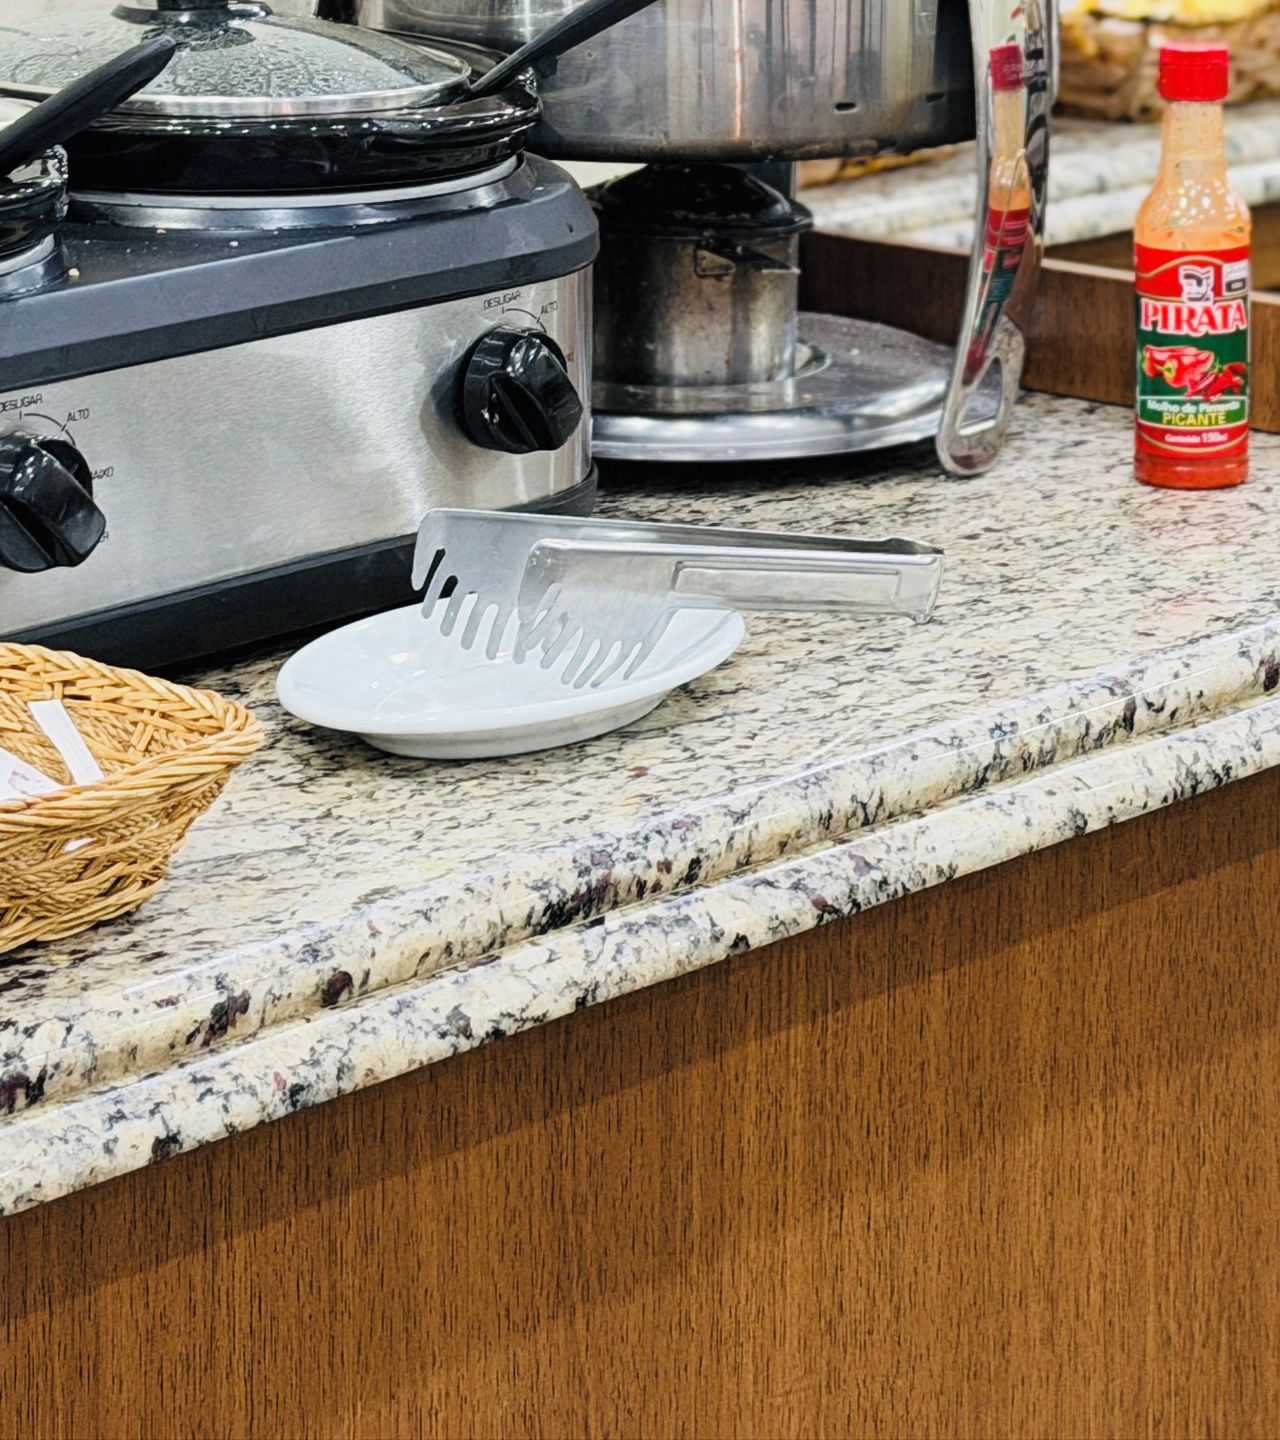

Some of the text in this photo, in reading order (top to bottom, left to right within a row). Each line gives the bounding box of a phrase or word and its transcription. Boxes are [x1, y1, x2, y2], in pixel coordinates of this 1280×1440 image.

[1142, 299, 1248, 335] PIRATA
[66, 408, 91, 423] ALTO
[1162, 411, 1227, 427] PICANTE
